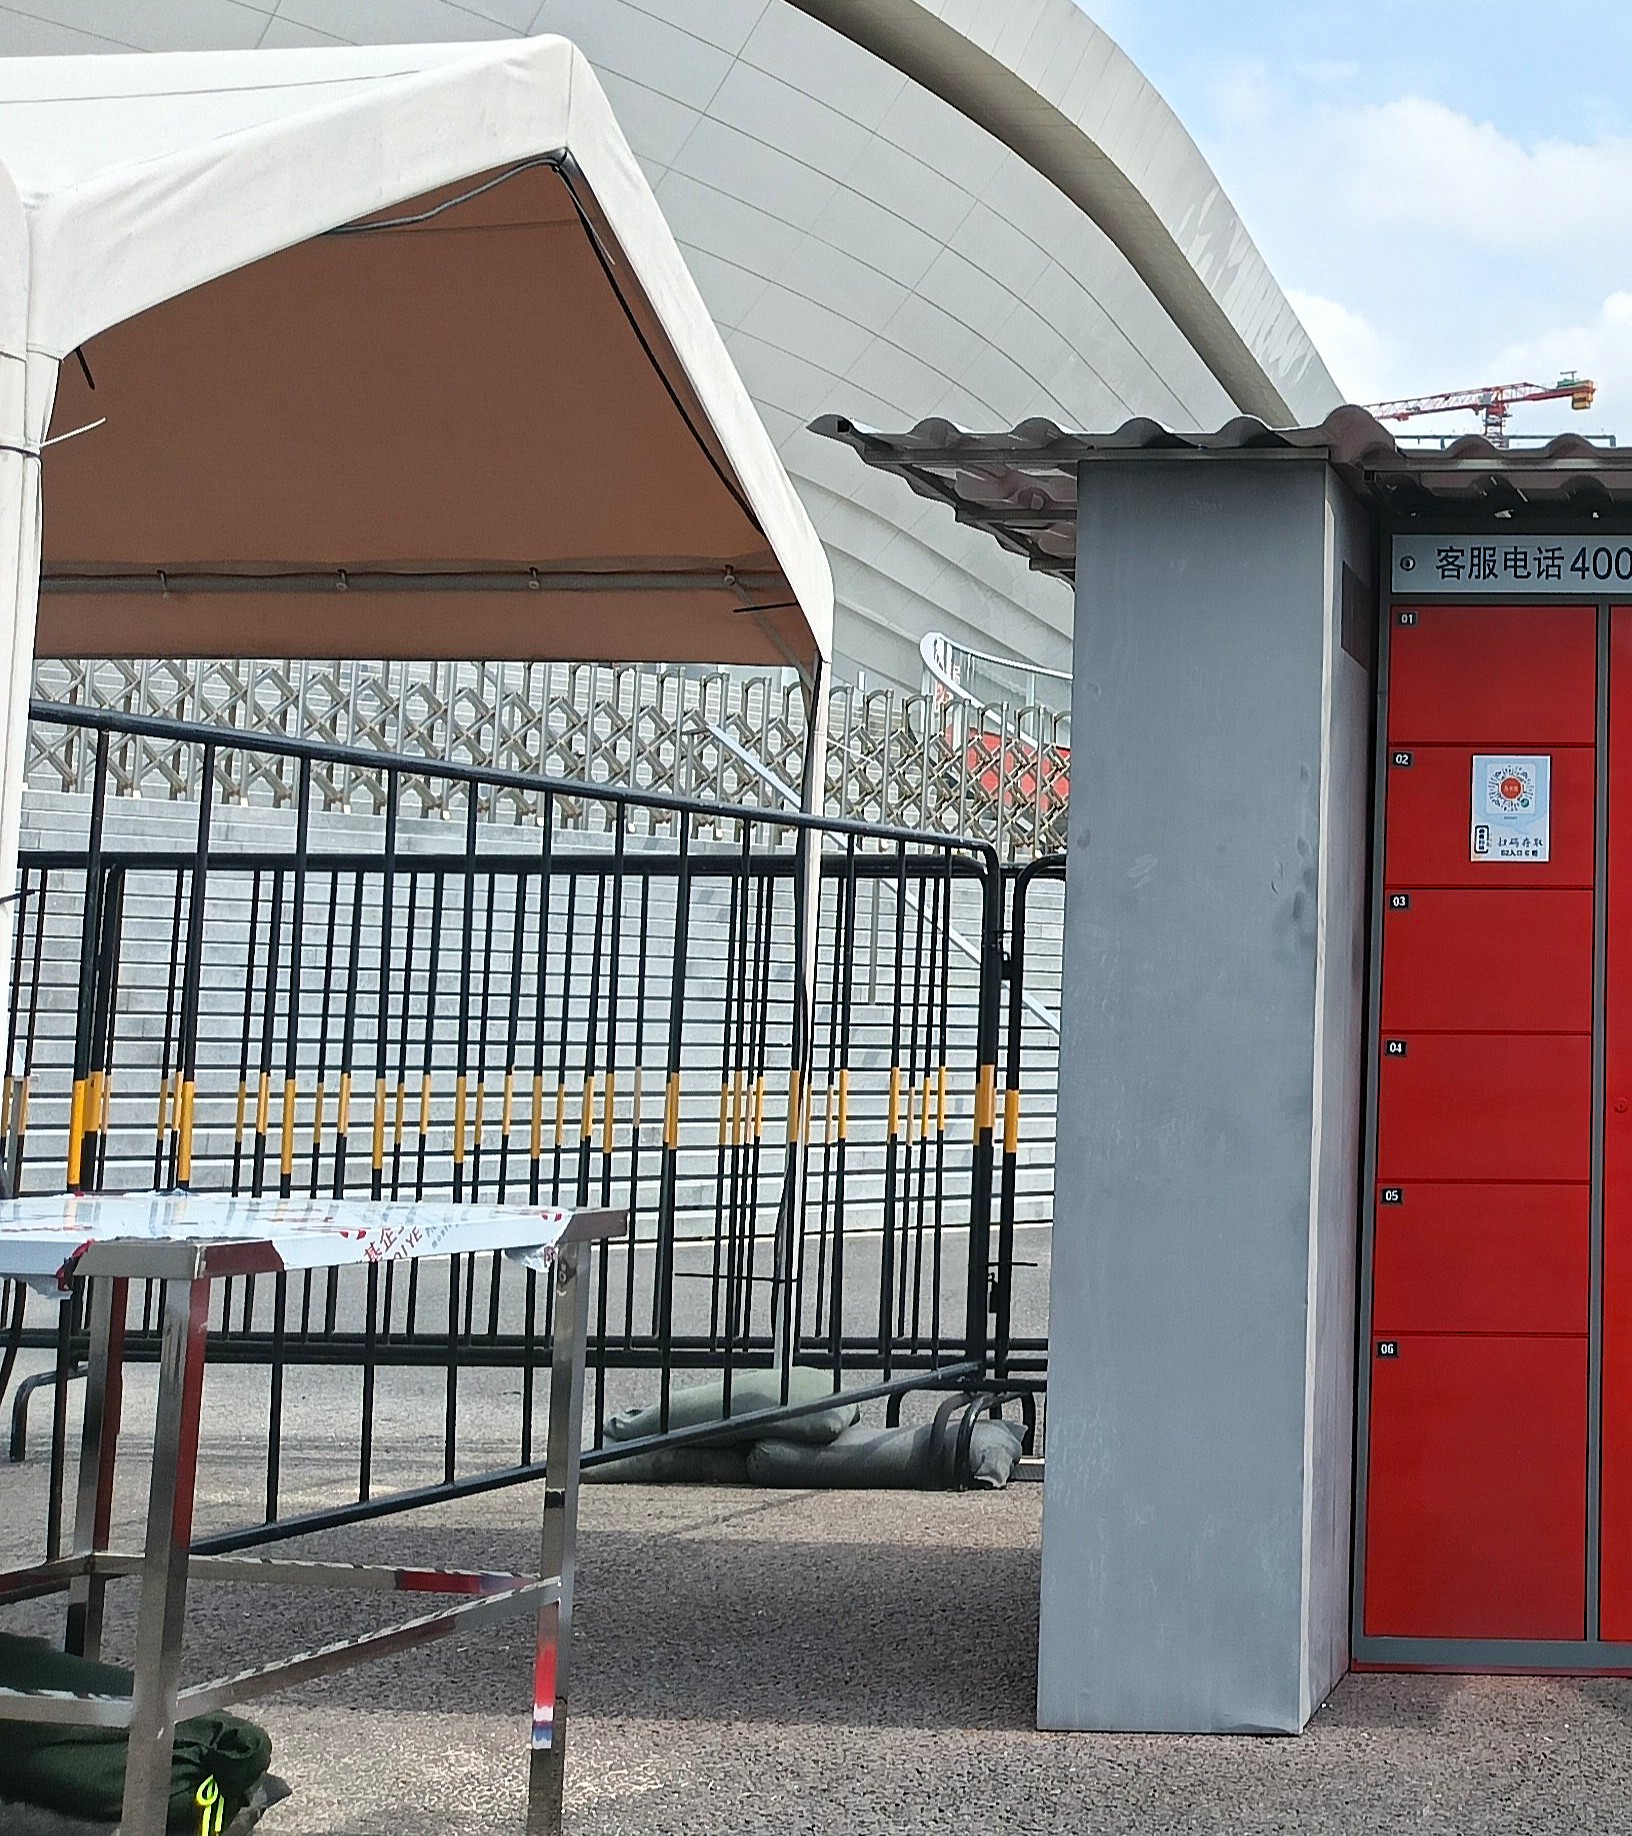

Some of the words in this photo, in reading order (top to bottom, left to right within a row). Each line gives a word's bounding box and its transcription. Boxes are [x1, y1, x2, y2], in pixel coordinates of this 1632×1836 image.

[1401, 614, 1413, 624] 01
[1395, 754, 1409, 765] 02
[1497, 836, 1544, 848] 扫码存取
[1392, 895, 1406, 907] 03
[1389, 1041, 1402, 1053] 04
[1385, 1189, 1399, 1201] 05
[1380, 1343, 1394, 1355] 06
